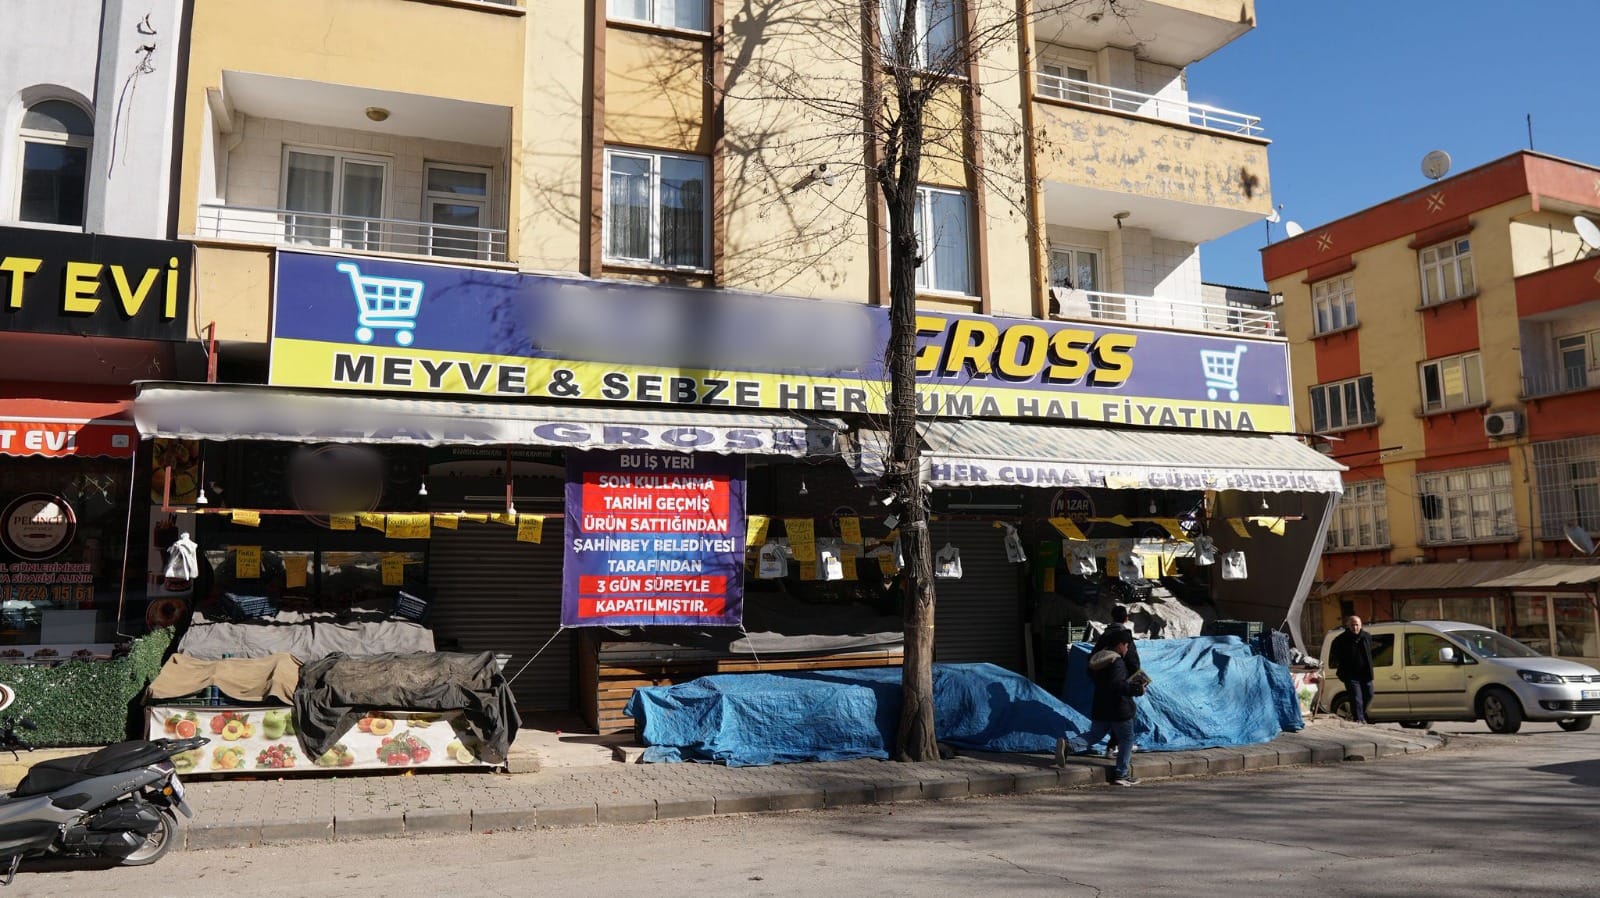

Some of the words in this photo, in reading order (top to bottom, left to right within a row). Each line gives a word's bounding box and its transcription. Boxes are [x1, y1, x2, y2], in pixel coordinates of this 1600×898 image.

[0, 257, 42, 307] T
[64, 257, 180, 318] EVİ
[914, 316, 1137, 385] GROSS
[334, 353, 527, 394] MEYVE
[548, 369, 580, 396] &
[601, 372, 760, 407] SEBZE
[779, 383, 868, 413] HER
[885, 391, 1001, 417] UMA
[1017, 398, 1088, 420] HAL
[1102, 399, 1255, 431] FİYATINA
[0, 430, 17, 449] T
[533, 423, 807, 451] GROSS
[620, 455, 641, 468] BU
[645, 453, 657, 470] İŞ
[662, 453, 695, 469] YERİ
[599, 475, 631, 489] SON
[634, 476, 714, 490] KULLANMA
[930, 464, 989, 482] HER
[998, 467, 1082, 485] CUMA
[1150, 468, 1219, 488] GÜNÜ
[604, 494, 652, 510] TARİHİ
[656, 496, 710, 512] GEÇMİŞ
[584, 517, 627, 531] ÜRÜN
[630, 516, 727, 532] SATTIĞINDAN
[573, 537, 650, 553] ŞAHİNBEY
[654, 537, 736, 553] BELEDİYESİ
[608, 560, 701, 573] TARAFINDAN
[18, 585, 48, 600] 724
[53, 585, 70, 600] 15
[76, 585, 94, 600] 61
[597, 580, 606, 592] 3
[609, 577, 640, 592] GÜN
[645, 577, 710, 592] SÜREYLE
[596, 600, 708, 614] KAPATILMIŞTIR.
